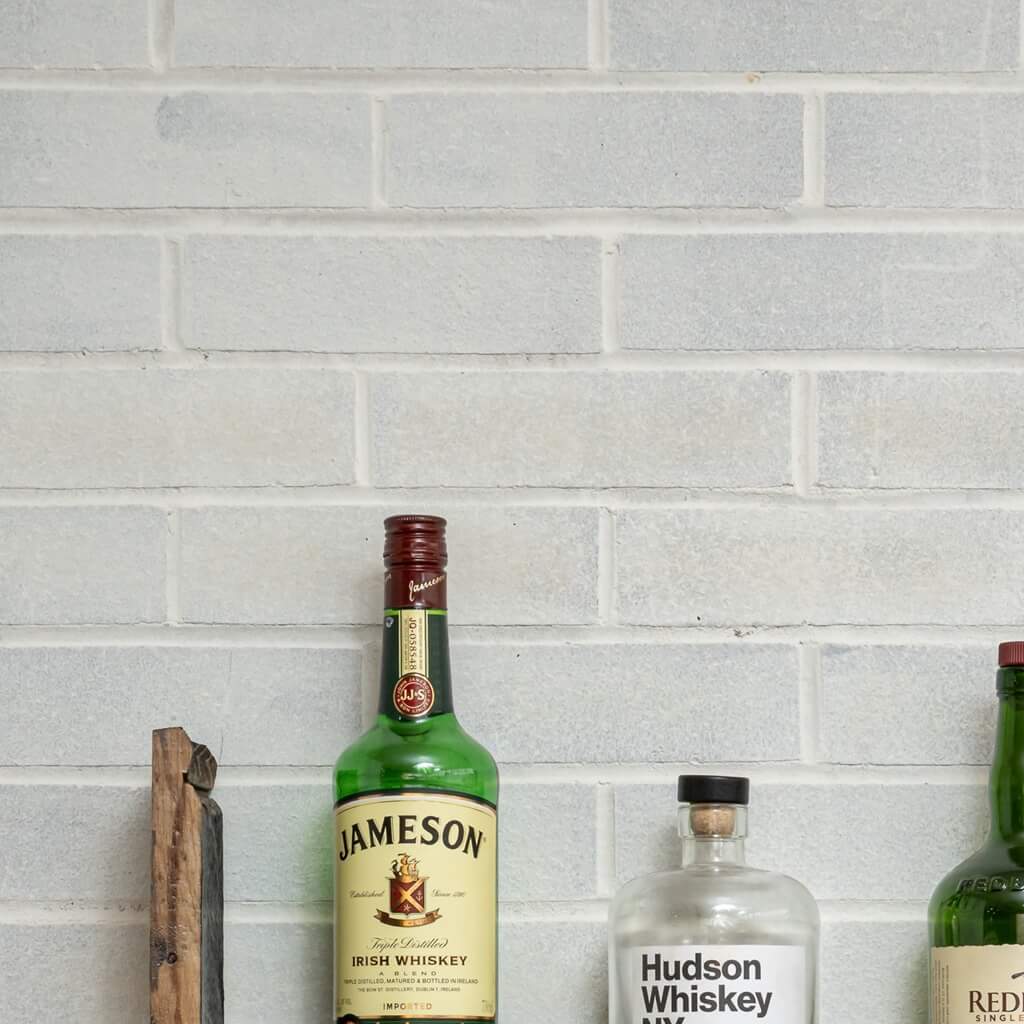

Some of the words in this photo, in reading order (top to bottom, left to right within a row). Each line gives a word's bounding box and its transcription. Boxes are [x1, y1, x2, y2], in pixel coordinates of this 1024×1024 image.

[339, 815, 484, 861] JAMESON
[352, 955, 390, 967] IRISH
[395, 955, 468, 966] WHISKEY
[641, 953, 761, 981] Hudson
[641, 984, 773, 1018] Whiskey
[975, 1014, 1024, 1022] SINGLE
